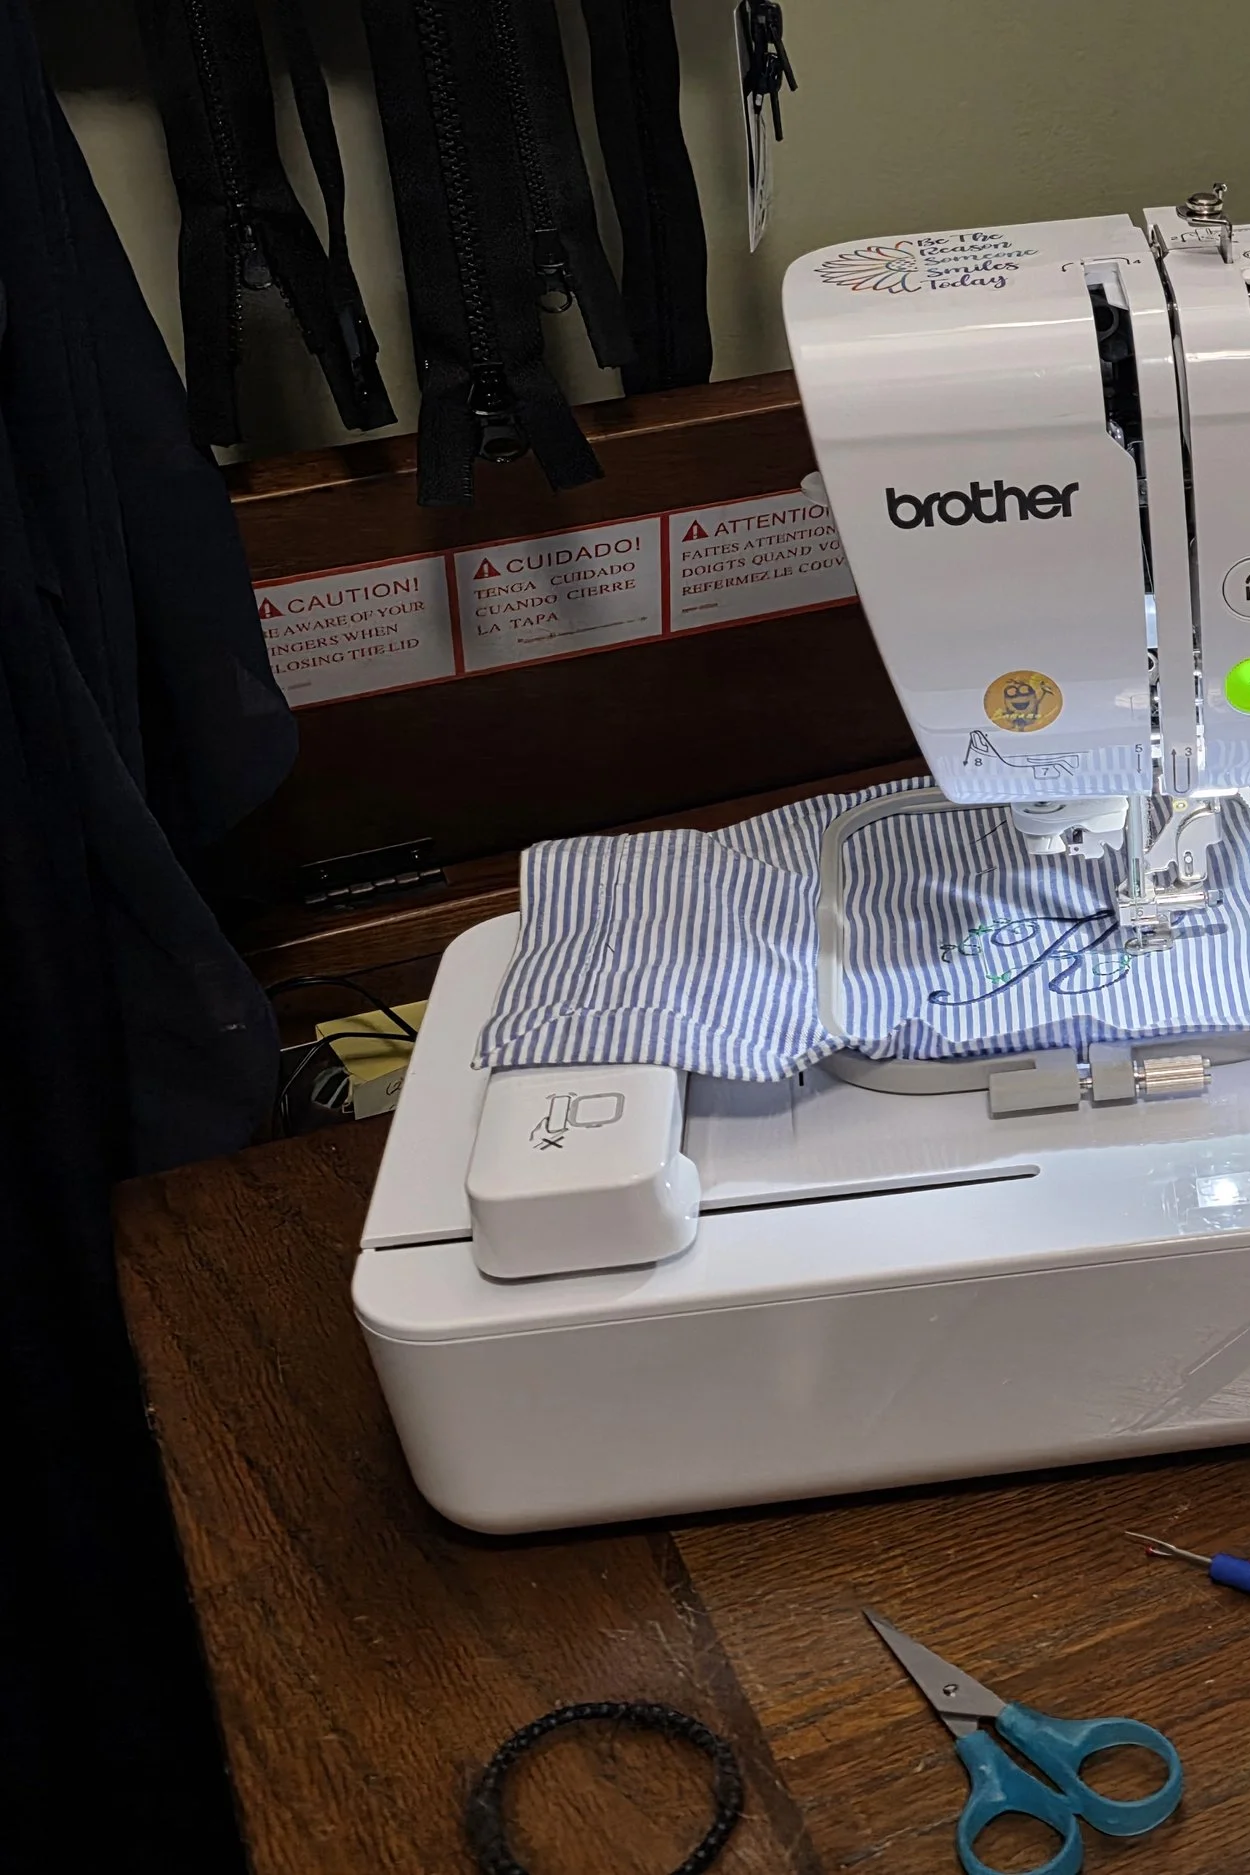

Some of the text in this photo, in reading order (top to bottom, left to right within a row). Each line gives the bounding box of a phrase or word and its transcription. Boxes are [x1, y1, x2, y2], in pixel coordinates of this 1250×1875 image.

[918, 232, 1004, 247] Be The
[920, 242, 1012, 256] Reason
[924, 249, 1040, 266] Someone
[927, 260, 1019, 278] Smiles
[920, 274, 1008, 289] Today
[885, 480, 1079, 529] brother
[506, 537, 640, 573] CUIDADO!
[682, 542, 739, 562] FAITES
[682, 540, 840, 578] DOIGTS QUAND VO
[473, 562, 636, 600] TENGA CUIDADO
[682, 556, 845, 596] REFERMEZ LE COUV
[288, 577, 419, 614] CAUTION!
[475, 579, 636, 617] CUANDO CIERRE
[284, 614, 348, 636] AWARE
[377, 601, 425, 617] YOUR
[477, 624, 501, 636] LA
[510, 612, 559, 629] TAPA
[271, 624, 398, 657] INGERS WHEN
[272, 638, 419, 674] LOSING THE LID
[974, 758, 983, 767] 8
[1135, 744, 1143, 753] 5
[1185, 747, 1192, 757] 3
